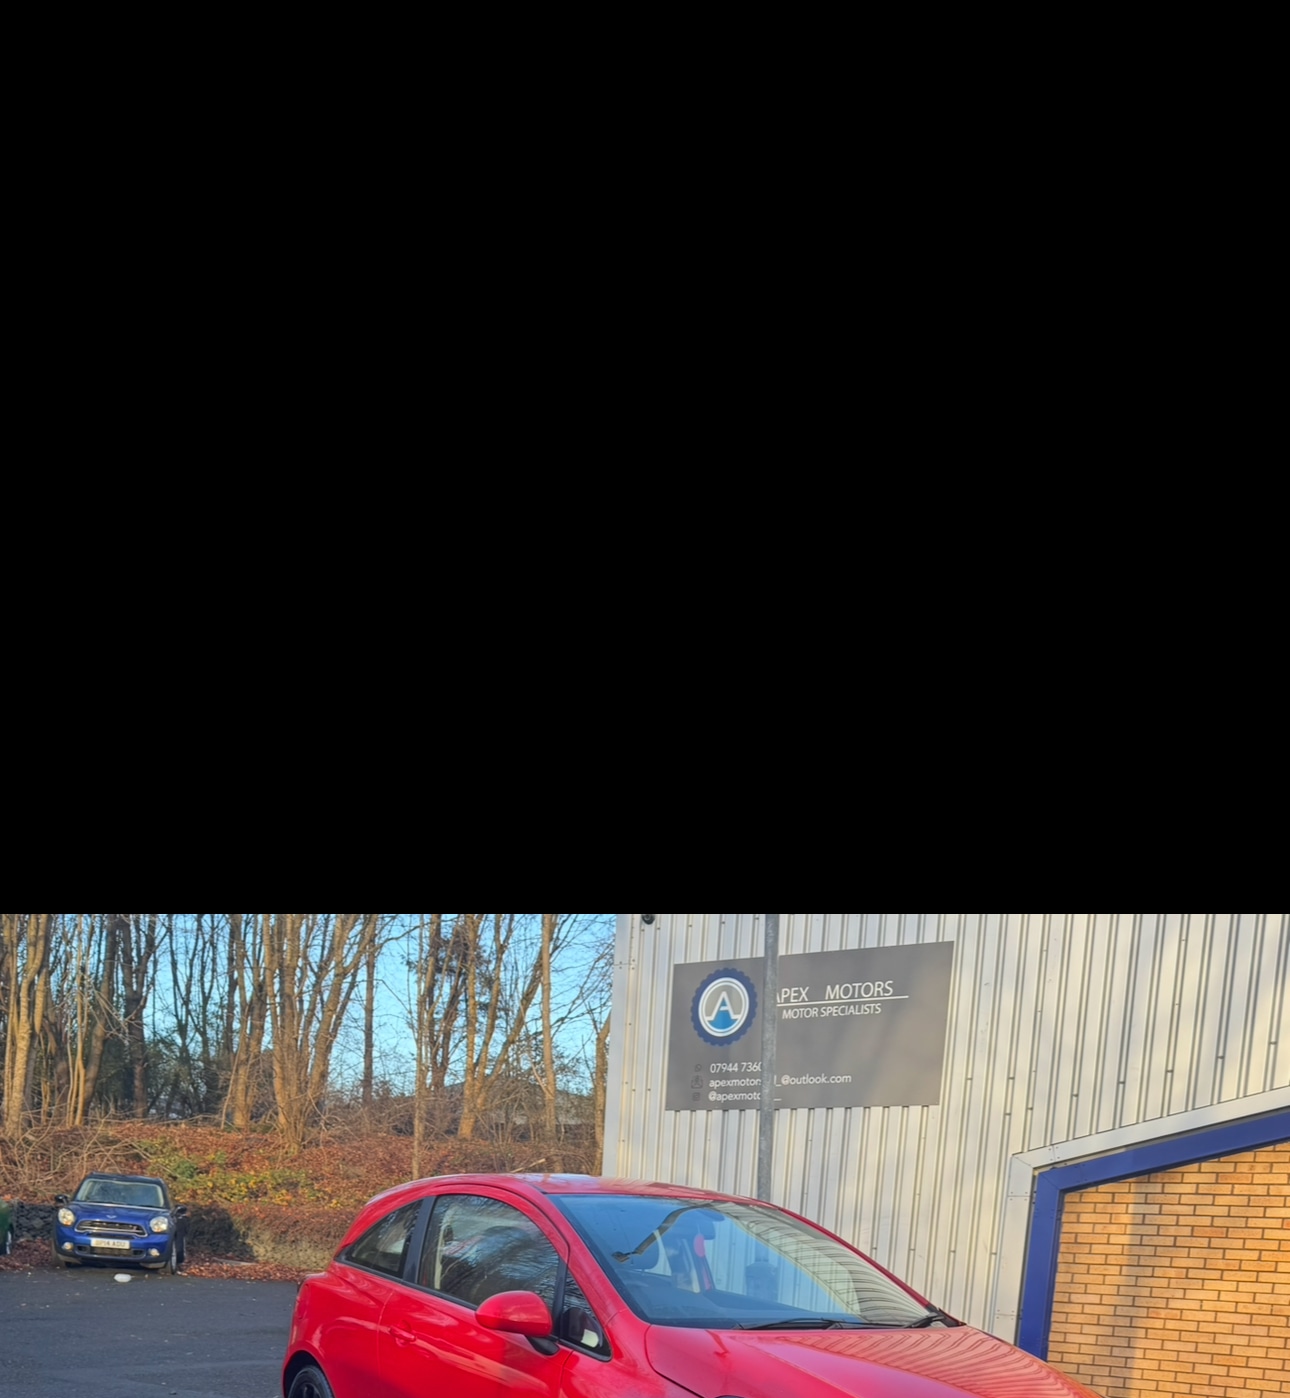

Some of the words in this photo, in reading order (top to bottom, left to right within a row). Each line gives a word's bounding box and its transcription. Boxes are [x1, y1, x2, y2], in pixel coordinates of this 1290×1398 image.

[825, 980, 893, 1000] MOTORS
[782, 1008, 819, 1020] MOTOR
[820, 1003, 882, 1017] SPECIALISTS
[709, 1062, 739, 1074] 07944
